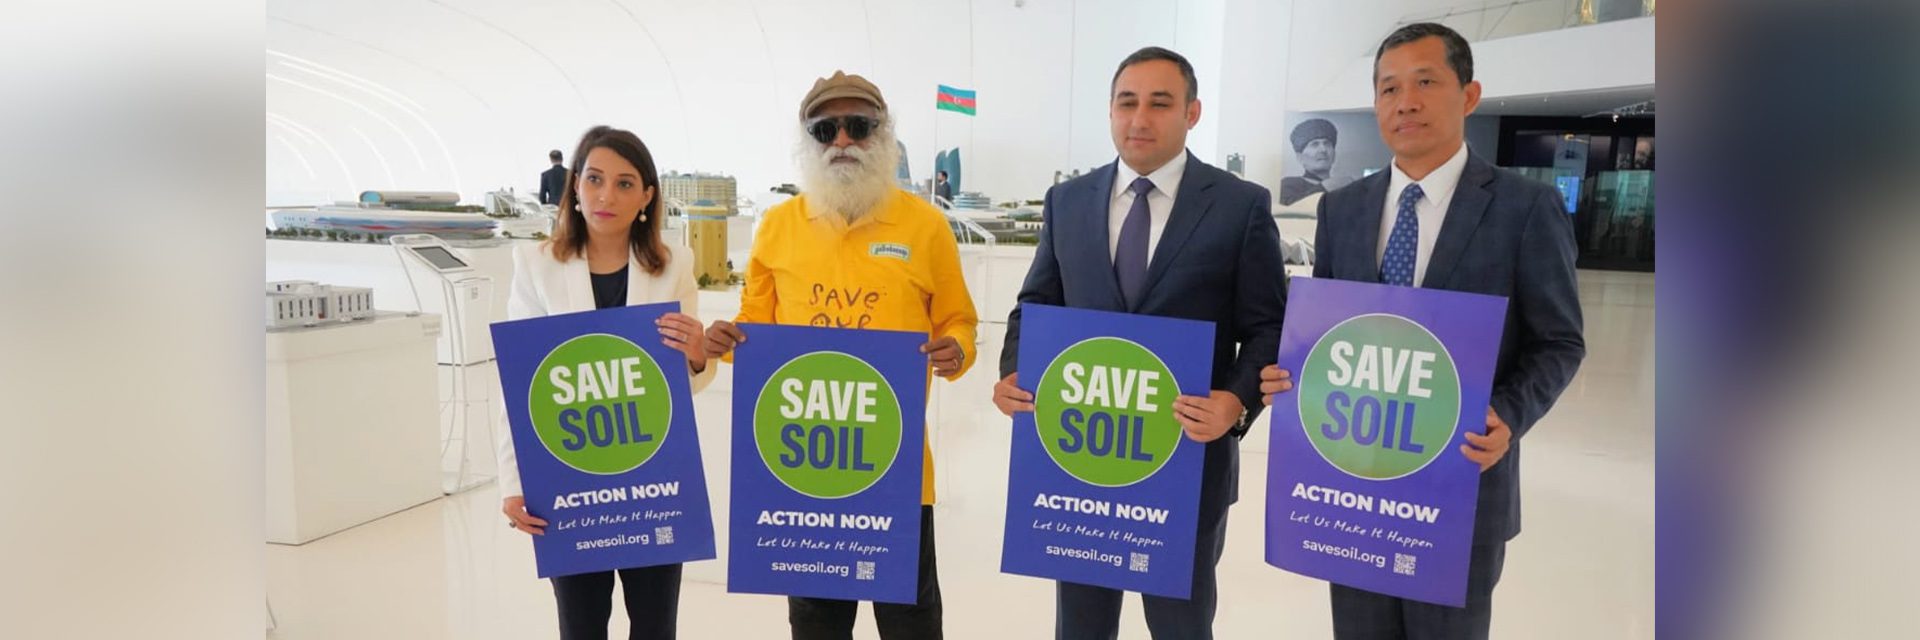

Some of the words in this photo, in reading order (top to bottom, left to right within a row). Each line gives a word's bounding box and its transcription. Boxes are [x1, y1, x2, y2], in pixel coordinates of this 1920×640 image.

[549, 356, 646, 405] SAVE
[1327, 340, 1436, 399] SAVE
[780, 377, 877, 422] SAVE
[1060, 362, 1160, 412] SAVE
[558, 401, 653, 451] SOIL
[1058, 408, 1154, 462] SOIL
[1321, 390, 1424, 454] SOIL
[779, 423, 874, 471] SOIL
[553, 487, 627, 510] ACTION
[631, 481, 680, 499] NOW
[1033, 493, 1110, 516] ACTION
[1116, 503, 1169, 524] NOW
[1291, 482, 1373, 512] ACTION
[1379, 499, 1440, 523] NOW
[558, 519, 576, 531] Let
[581, 517, 595, 527] Us
[631, 512, 641, 521] It
[645, 509, 682, 521] Happen
[757, 510, 834, 528] ACTION
[840, 514, 892, 531] NOW
[1032, 519, 1052, 530] Let
[1056, 522, 1072, 533] Us
[1108, 530, 1119, 540] It
[1123, 532, 1164, 547] Happen
[1290, 511, 1310, 524] Let
[1314, 516, 1331, 528] Us
[1371, 527, 1383, 539] It
[1387, 530, 1434, 548] Happen
[576, 534, 649, 550] savesoil.org
[757, 537, 776, 547] Let
[781, 537, 795, 548] Us
[835, 541, 845, 550] It
[849, 541, 889, 555] Happen
[1046, 545, 1123, 567] savesoil.org
[1302, 539, 1386, 568] savesoil.org
[771, 561, 849, 577] savesoil.org
